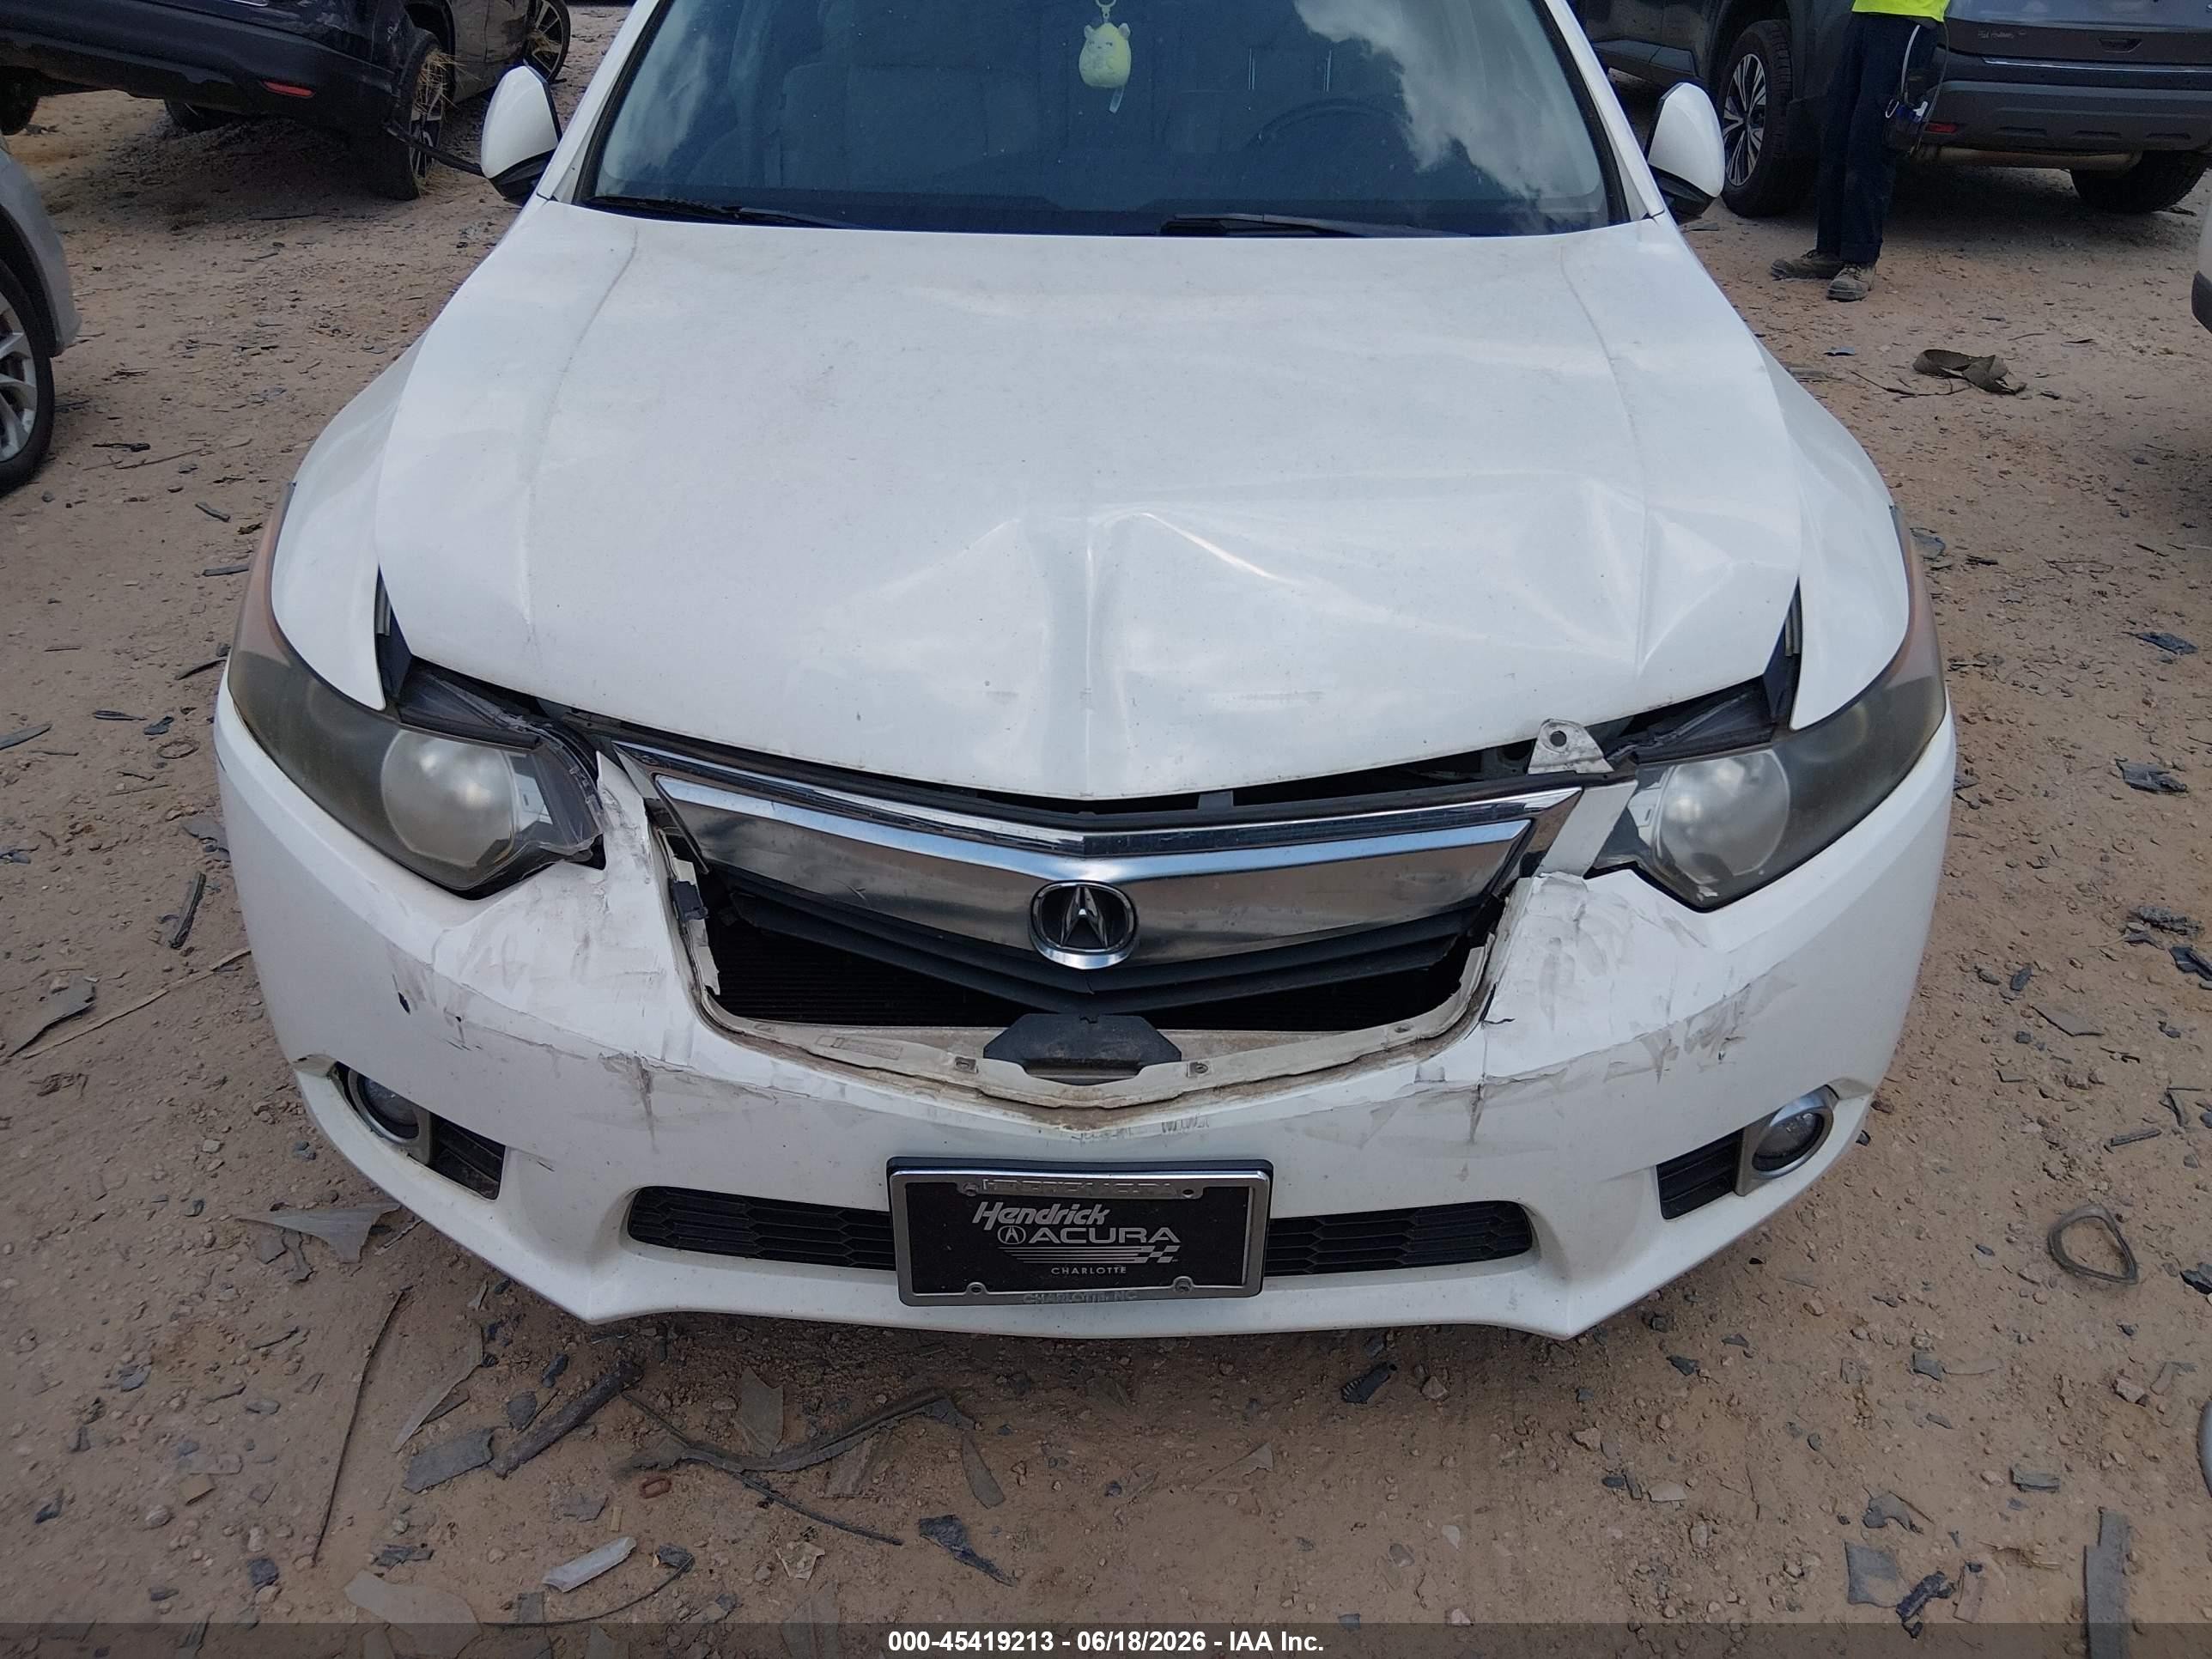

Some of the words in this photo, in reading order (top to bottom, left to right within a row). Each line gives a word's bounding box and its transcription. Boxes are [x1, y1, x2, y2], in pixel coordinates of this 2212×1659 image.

[972, 1201, 1110, 1230] Hendrick
[1028, 1227, 1181, 1243] ACURA
[1050, 1266, 1127, 1275] CHARLOTTE
